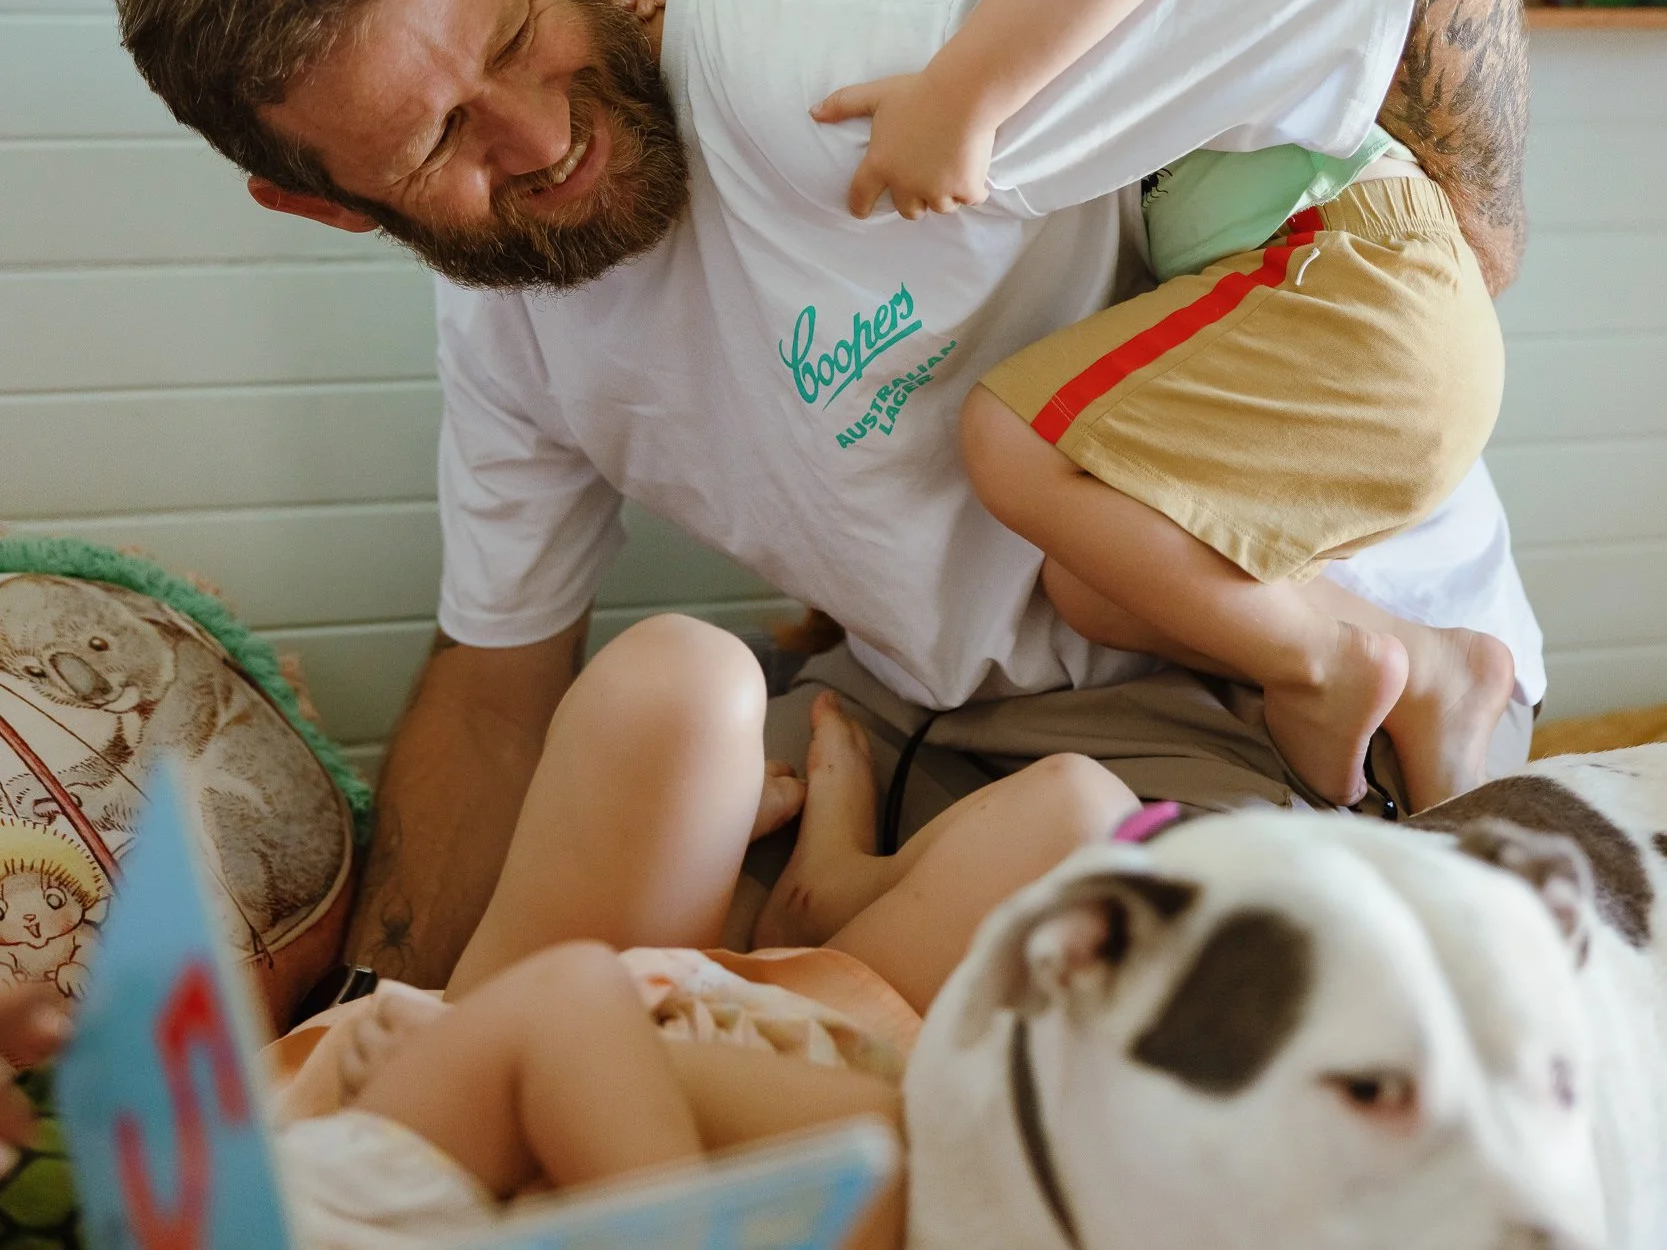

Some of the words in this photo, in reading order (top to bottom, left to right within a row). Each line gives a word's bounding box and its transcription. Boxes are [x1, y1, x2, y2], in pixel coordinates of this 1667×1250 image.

[779, 281, 914, 405] Coopers
[835, 339, 957, 449] AUSTRALIAN
[878, 374, 934, 437] LAGER
